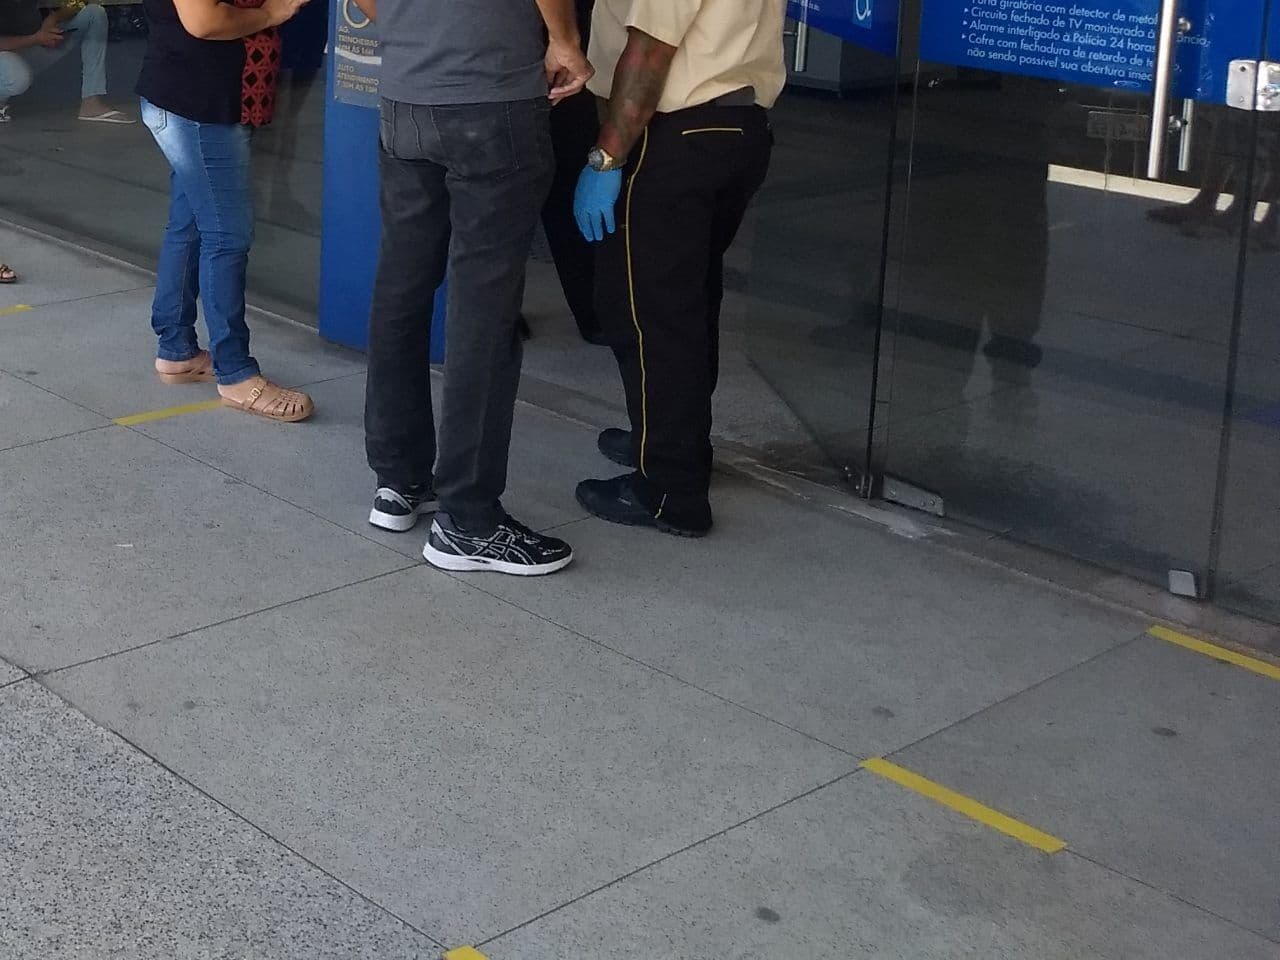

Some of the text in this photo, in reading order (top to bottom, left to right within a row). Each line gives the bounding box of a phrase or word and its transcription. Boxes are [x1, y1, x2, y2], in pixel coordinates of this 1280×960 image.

[970, 6, 1008, 21] Circuito
[1010, 9, 1050, 26] fechado
[1051, 15, 1066, 29] de
[1068, 17, 1084, 29] TV
[1084, 22, 1145, 38] monitorado
[1044, 3, 1066, 14] com
[1068, 4, 1110, 18] detector
[1112, 8, 1126, 21] de
[968, 33, 995, 46] Cofre
[996, 39, 1018, 50] com
[1020, 38, 1070, 57] fechadura
[1072, 46, 1086, 59] de
[1088, 49, 1127, 64] retardo
[1129, 53, 1143, 66] de
[969, 20, 1005, 34] Alarme
[1007, 25, 1061, 41] interligado
[1072, 31, 1107, 47] Polícia
[1109, 36, 1124, 49] 24
[967, 46, 986, 58] não
[987, 49, 1017, 62] sendo
[1018, 52, 1058, 68] possível
[1060, 60, 1079, 71] sua
[1080, 60, 1126, 78] abertura
